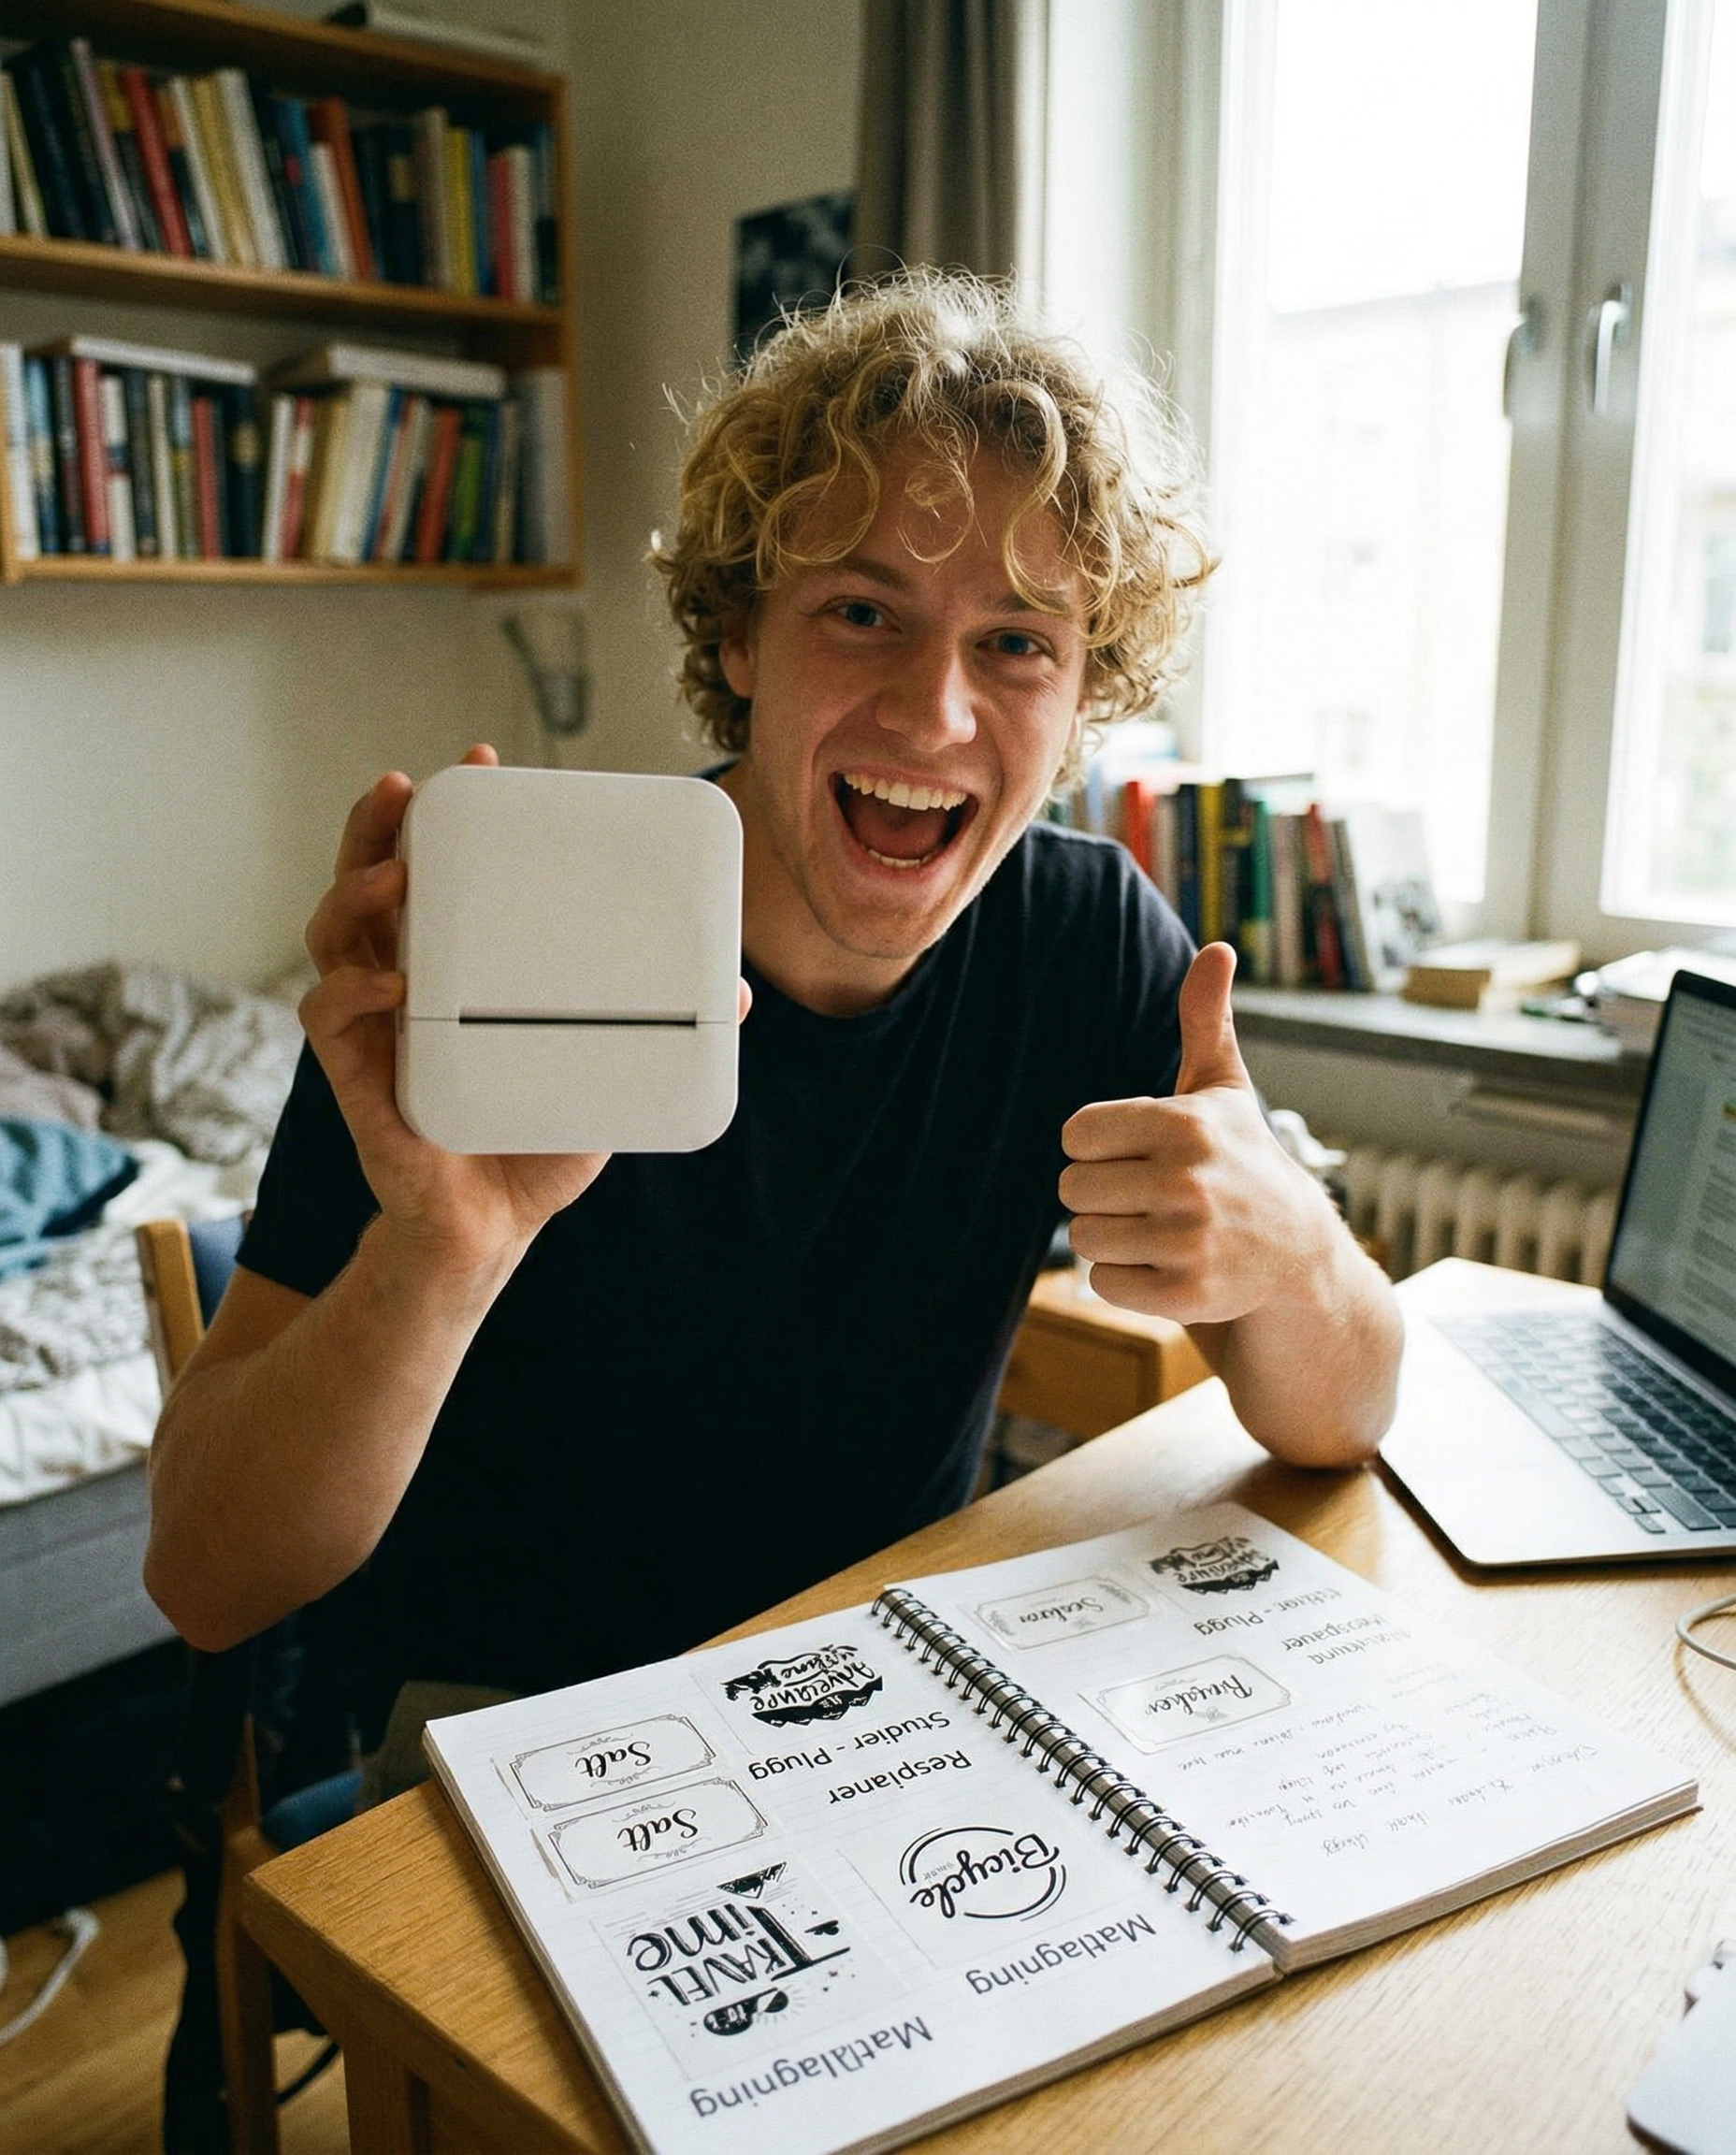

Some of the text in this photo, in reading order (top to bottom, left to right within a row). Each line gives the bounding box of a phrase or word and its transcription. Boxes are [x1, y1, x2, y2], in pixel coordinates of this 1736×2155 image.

[1194, 1611, 1263, 1637] Plugg
[854, 1711, 950, 1751] Studier
[574, 1741, 653, 1778] Salt
[748, 1747, 832, 1781] Plugg
[616, 1808, 699, 1852] Salt
[908, 1833, 1060, 1919] Bicycle
[965, 1914, 1157, 1996] Matlagning
